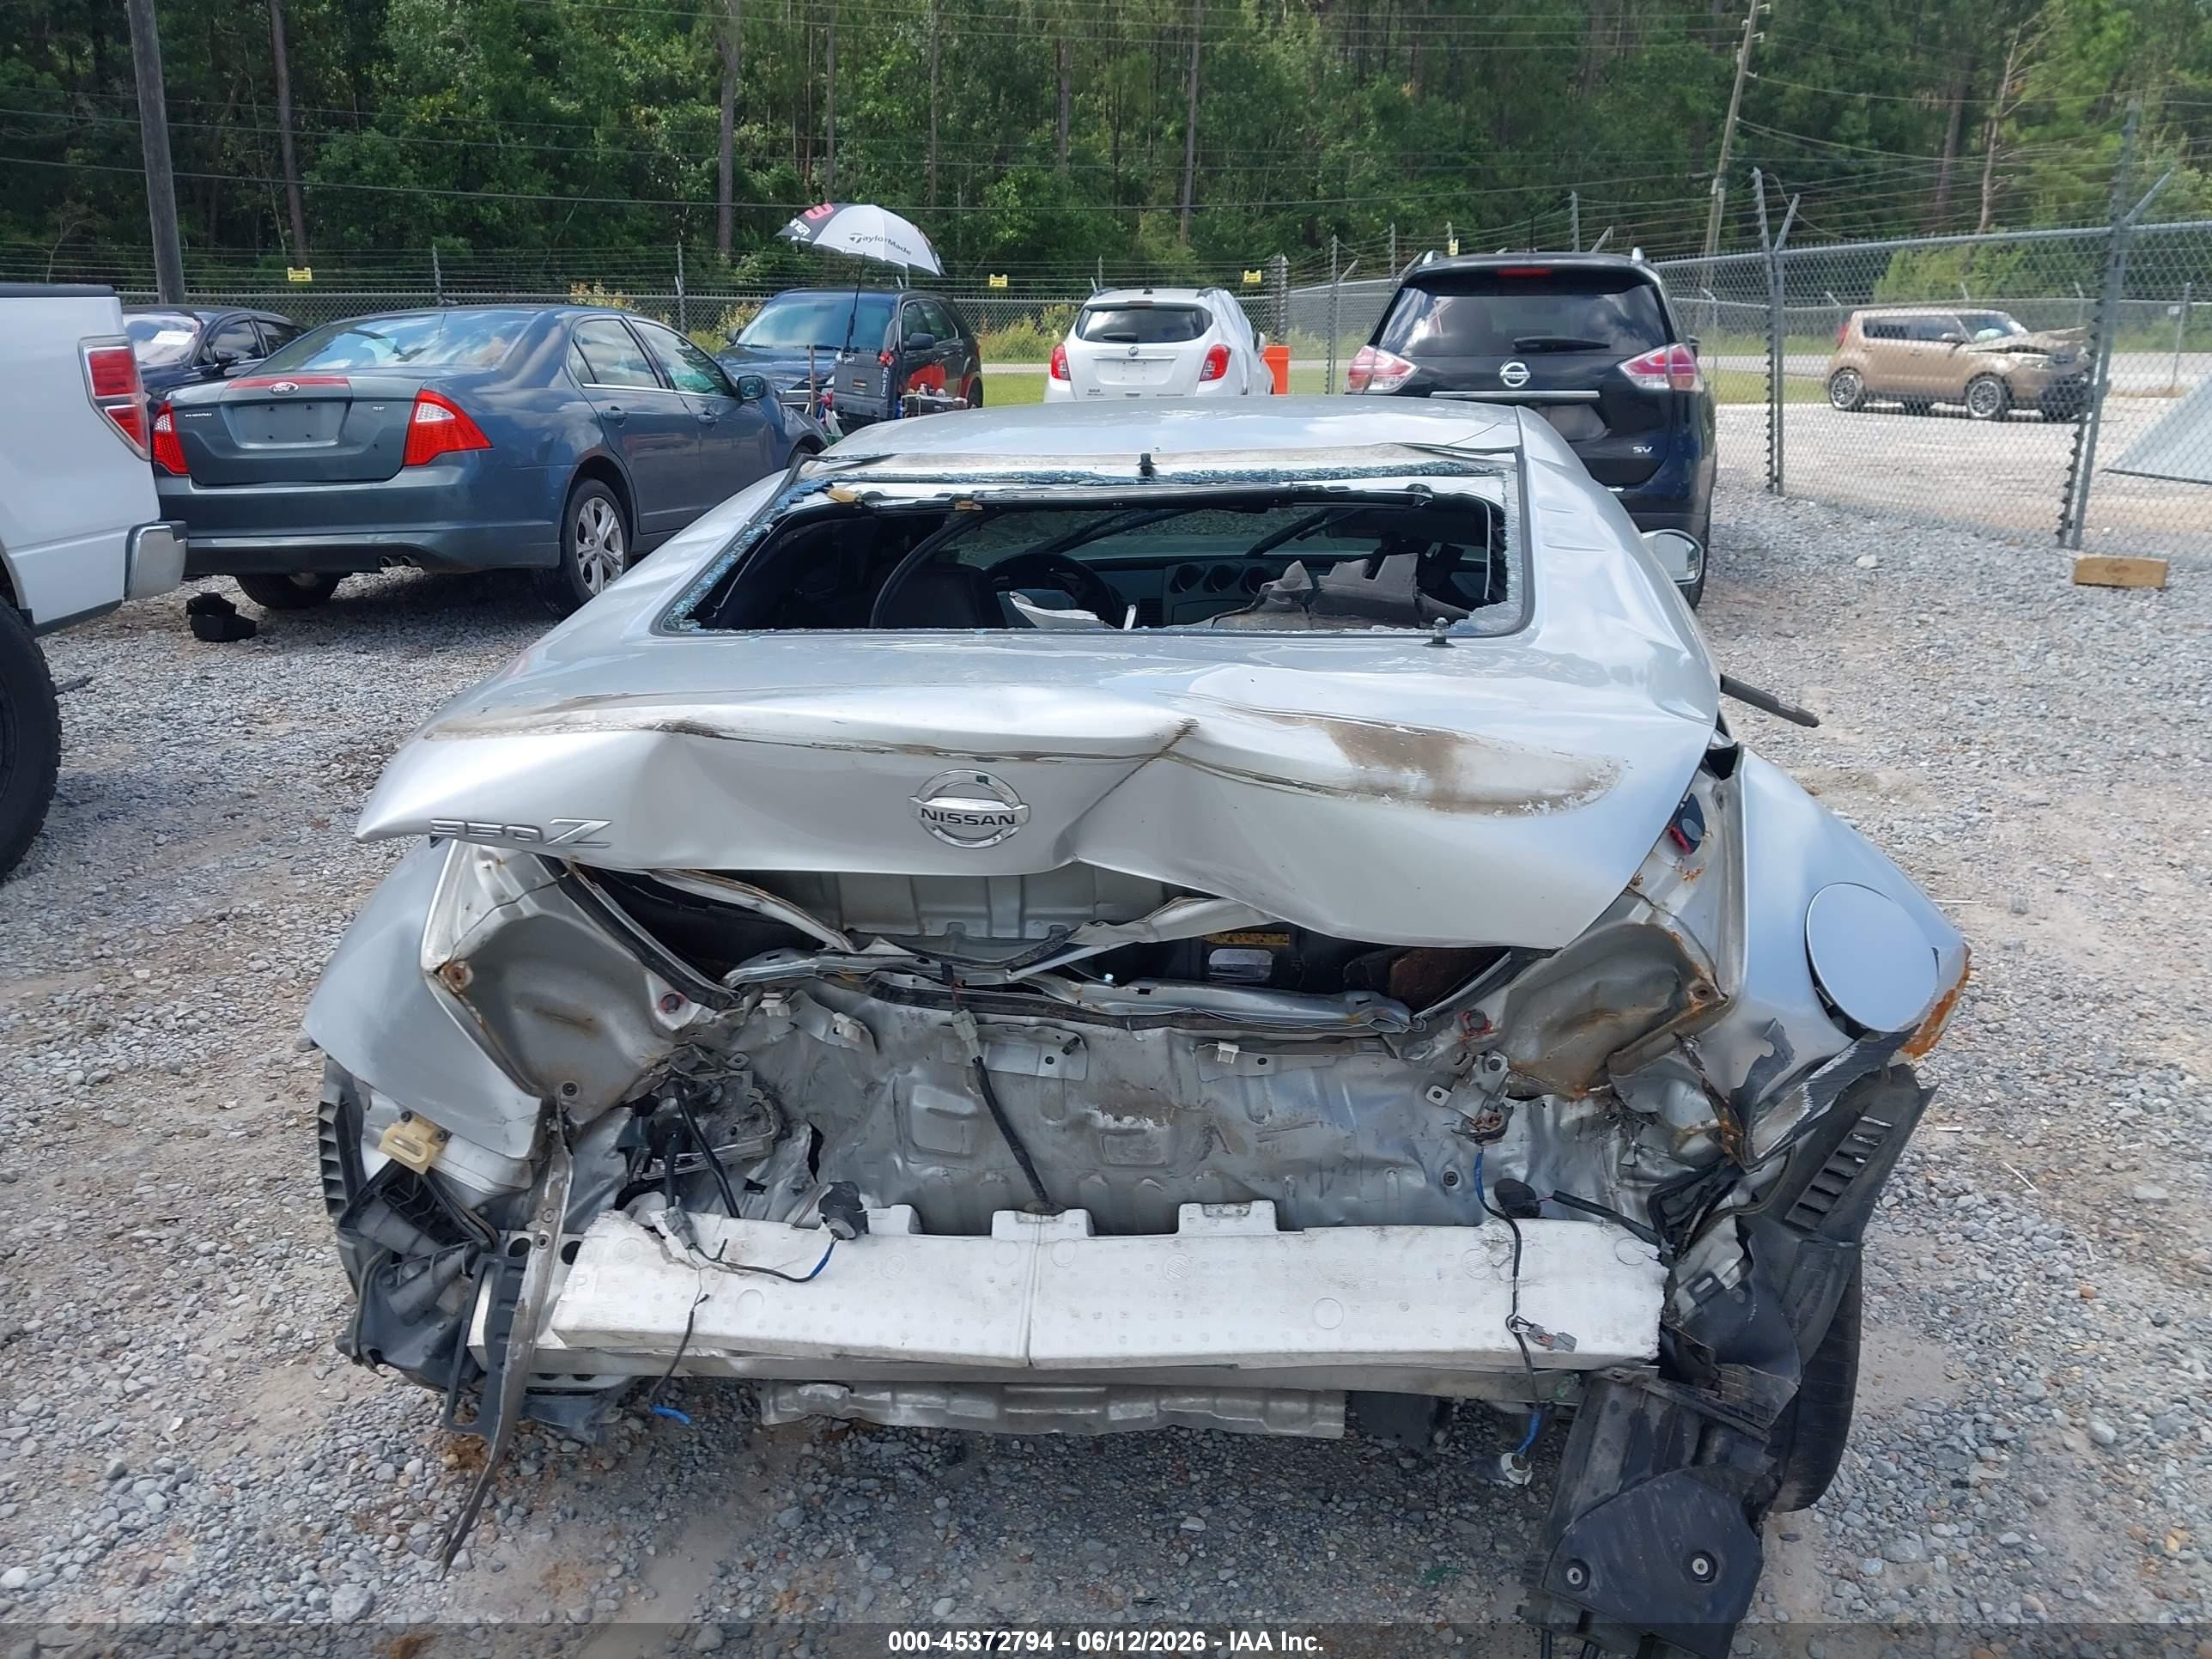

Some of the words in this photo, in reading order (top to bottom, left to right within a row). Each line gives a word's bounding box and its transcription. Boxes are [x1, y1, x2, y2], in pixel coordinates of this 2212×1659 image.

[848, 232, 912, 256] TaylorMade
[1632, 445, 1653, 453] SV
[921, 807, 1016, 826] NISSAN
[429, 817, 612, 849] 350Z
